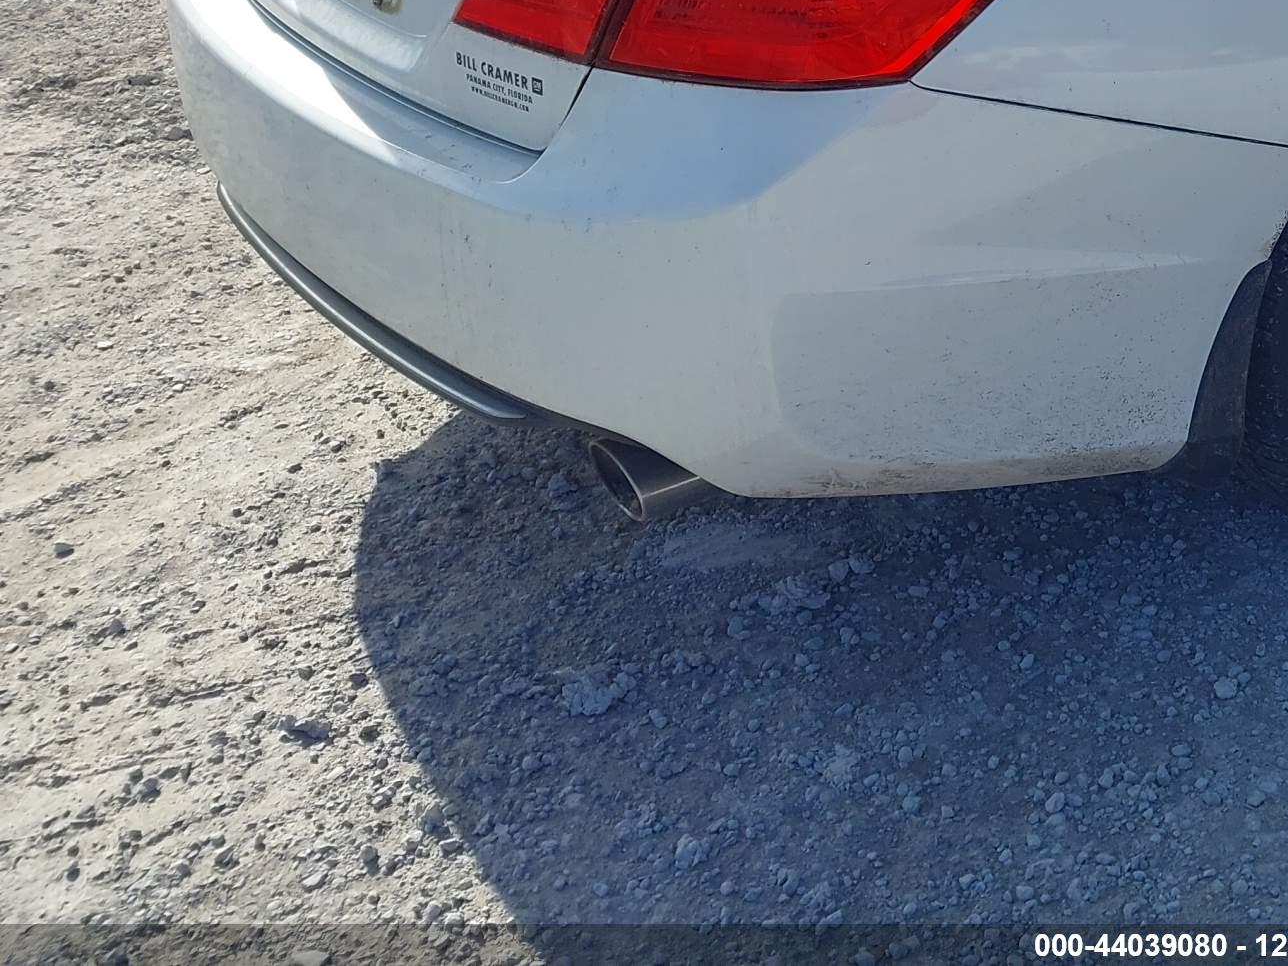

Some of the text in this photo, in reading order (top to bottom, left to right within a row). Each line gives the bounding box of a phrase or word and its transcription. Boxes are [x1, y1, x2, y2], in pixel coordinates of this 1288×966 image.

[456, 51, 477, 72] BILL
[480, 61, 528, 91] CRAMER
[466, 73, 491, 90] PANAMA
[507, 88, 533, 104] FLORIDA
